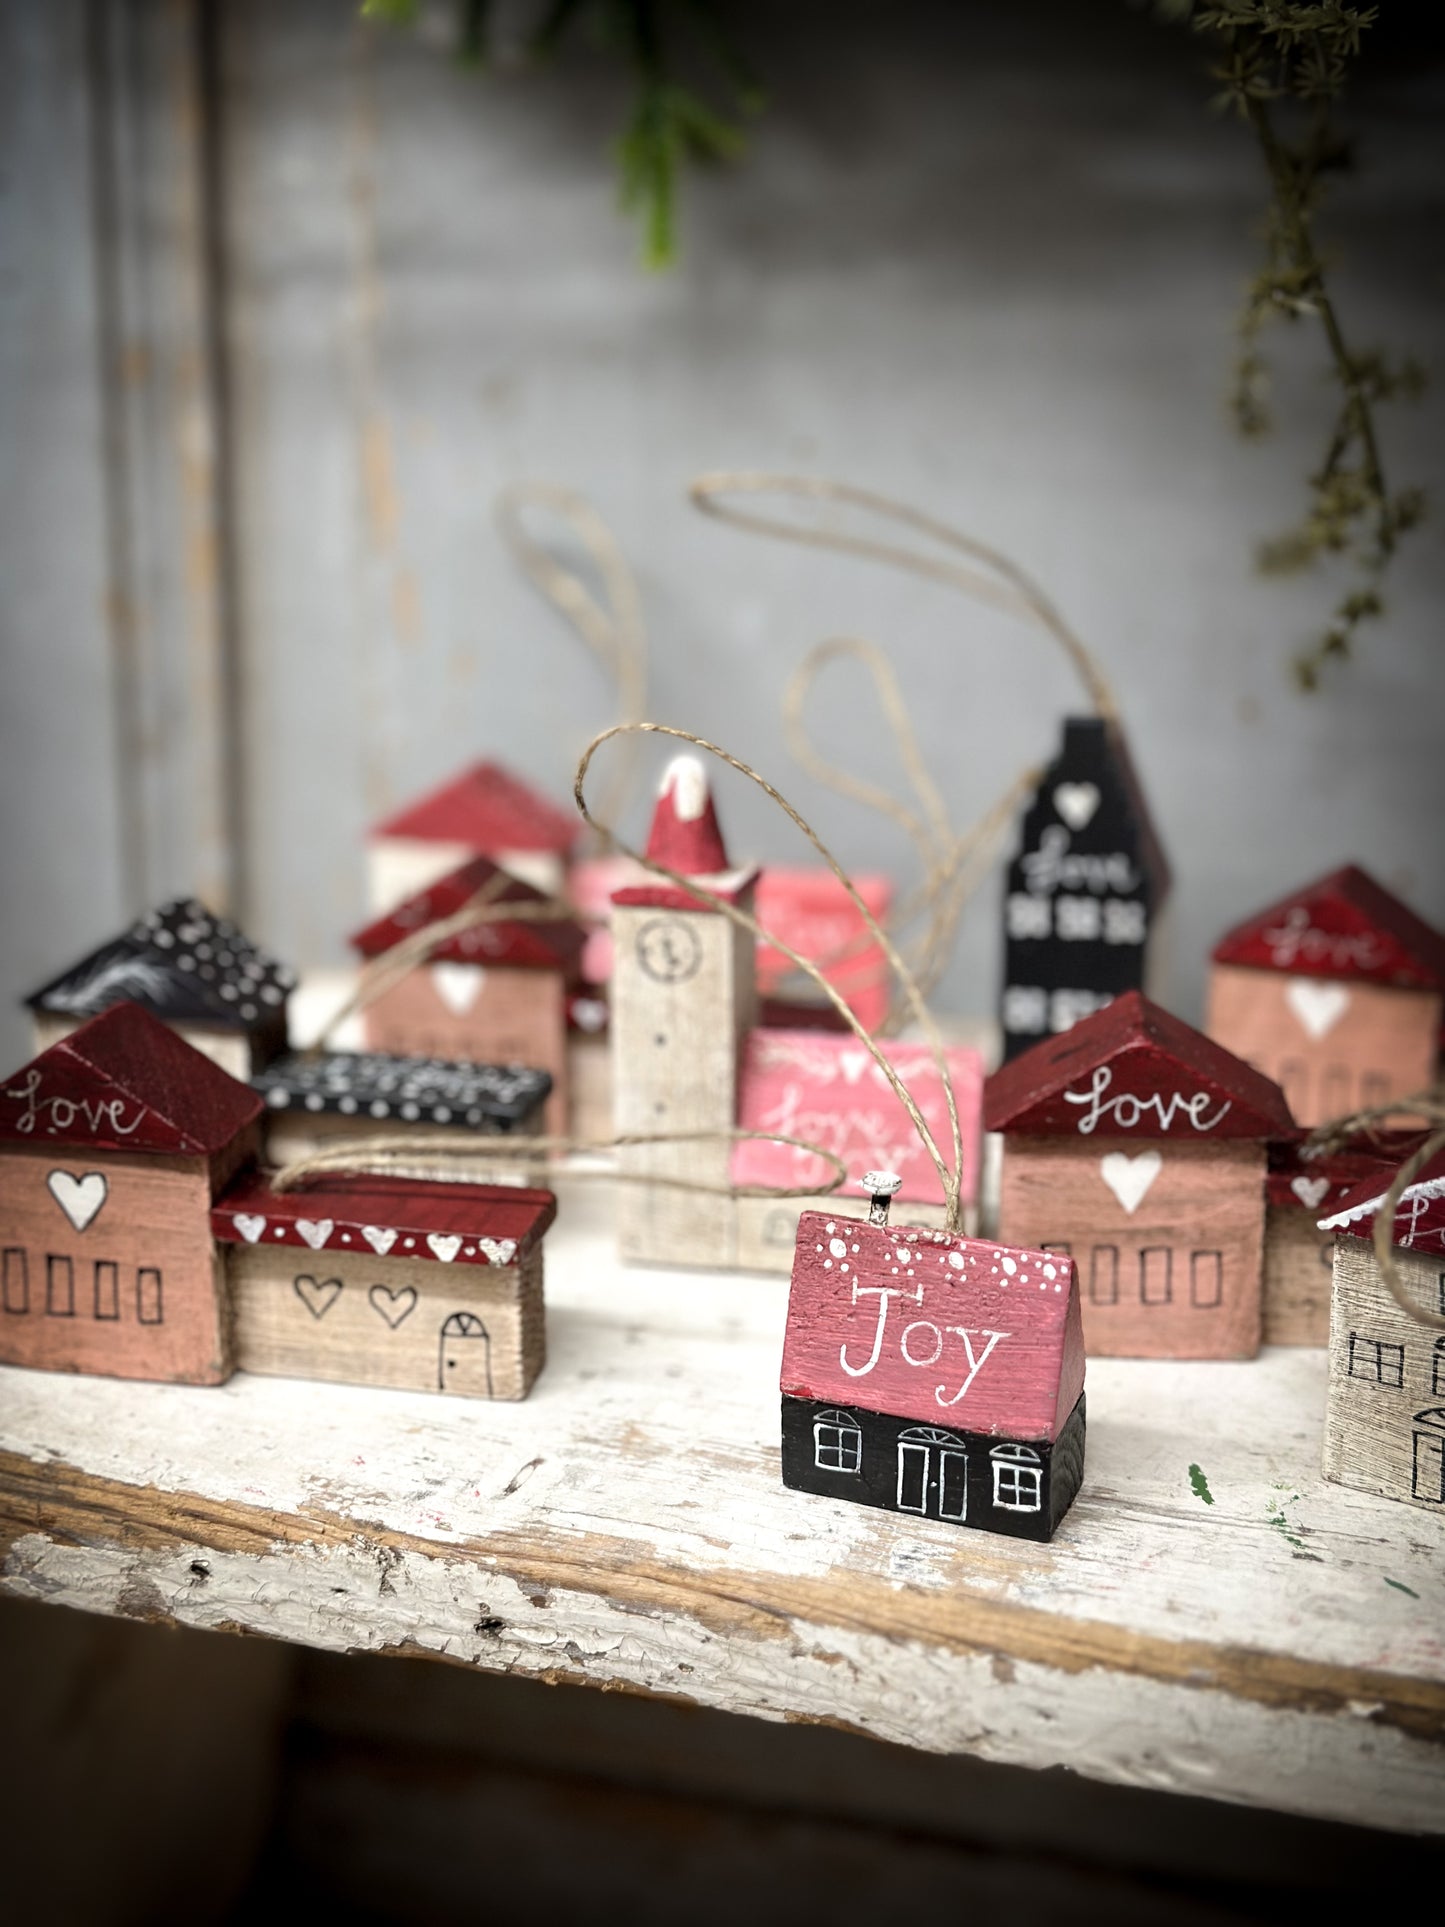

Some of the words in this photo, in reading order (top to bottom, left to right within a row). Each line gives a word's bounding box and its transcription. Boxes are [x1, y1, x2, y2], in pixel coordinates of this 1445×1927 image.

[7, 1069, 149, 1133] Love
[1064, 1066, 1232, 1134] Love
[1394, 1196, 1445, 1247] L
[840, 1275, 1012, 1406] Joy
